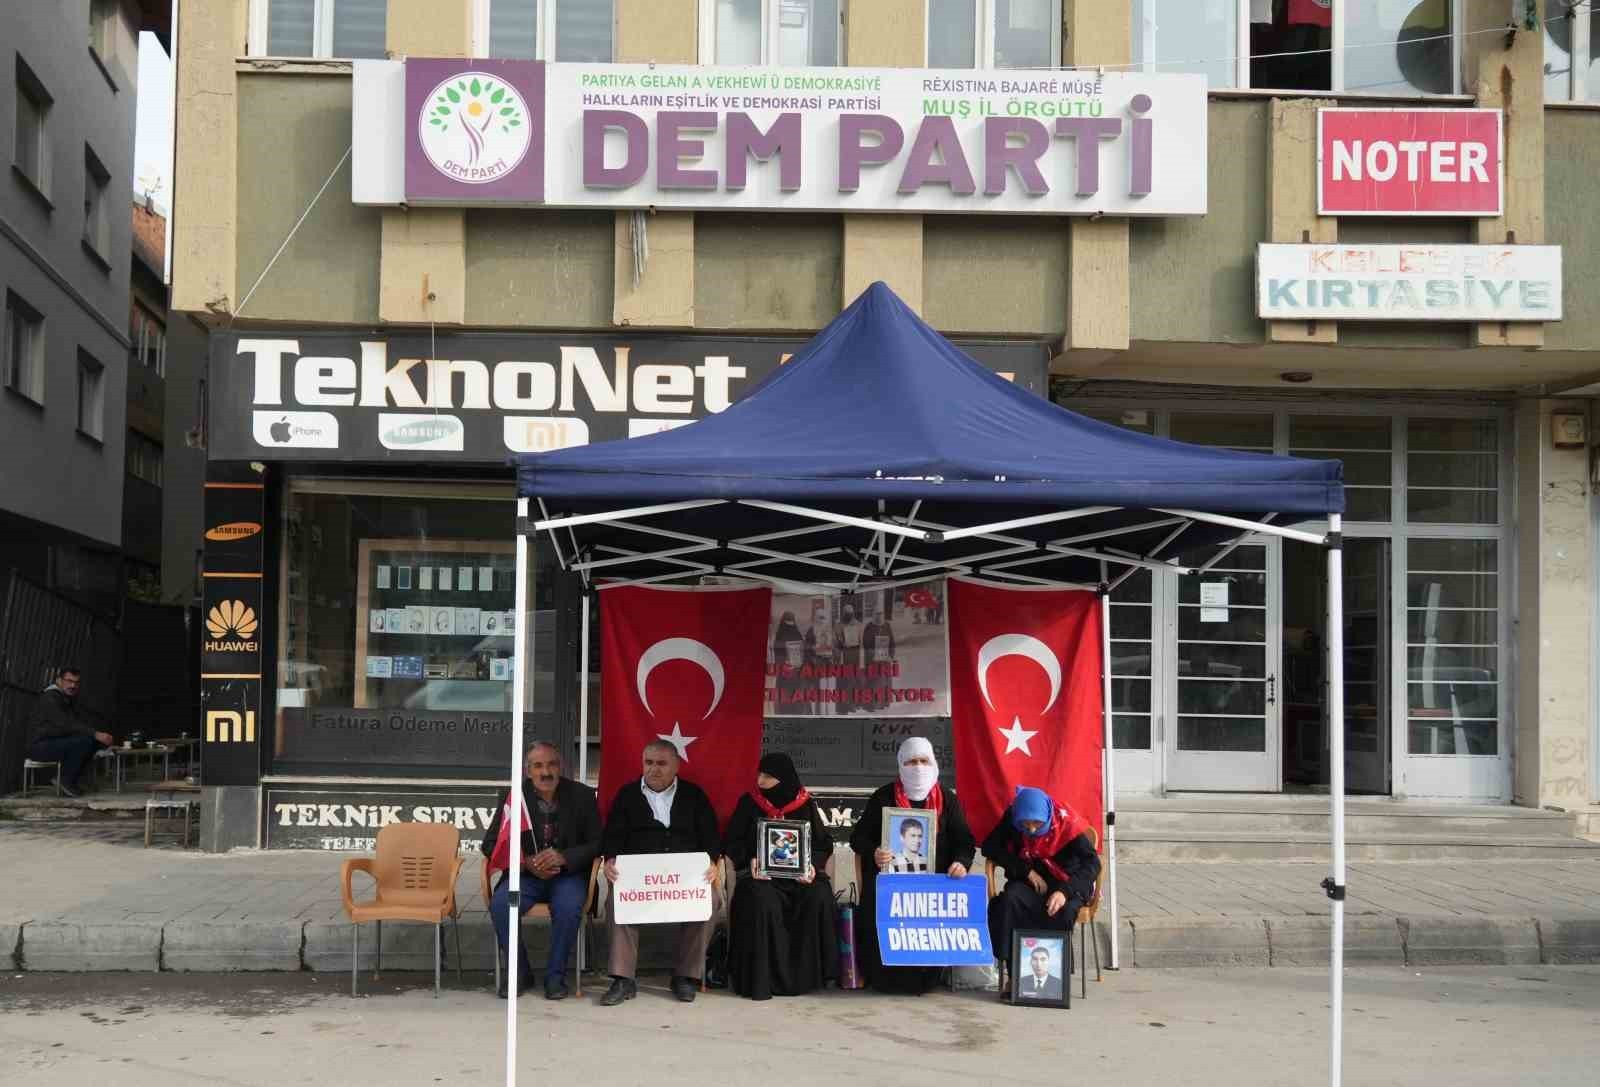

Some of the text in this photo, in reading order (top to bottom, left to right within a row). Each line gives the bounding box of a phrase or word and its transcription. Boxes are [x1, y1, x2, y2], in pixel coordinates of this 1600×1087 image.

[640, 75, 687, 88] GELAN
[583, 92, 881, 110] HALKLARIN EŞİTLİK VE DEMOKRASİ PARTİSİ
[923, 96, 1103, 118] MUŞ İL ÖRGÜTÜ
[582, 94, 1153, 198] DEM PARTİ
[444, 157, 508, 178] DEM PARTİ
[1331, 140, 1490, 183] NOTER
[1267, 276, 1553, 309] KIRTASİYE
[236, 338, 747, 415] TeknoNet
[292, 425, 323, 438] iPhone
[213, 526, 255, 536] SAMSUNG
[205, 641, 258, 652] HUAWEI
[311, 712, 537, 734] Fatura Ödeme Merkzi
[412, 806, 498, 830] SERV
[644, 873, 681, 886] EVLAT
[619, 888, 706, 902] NÖBETİNDEYİZ
[889, 891, 969, 919] ANNELER
[888, 920, 982, 951] DİRENİYOR
